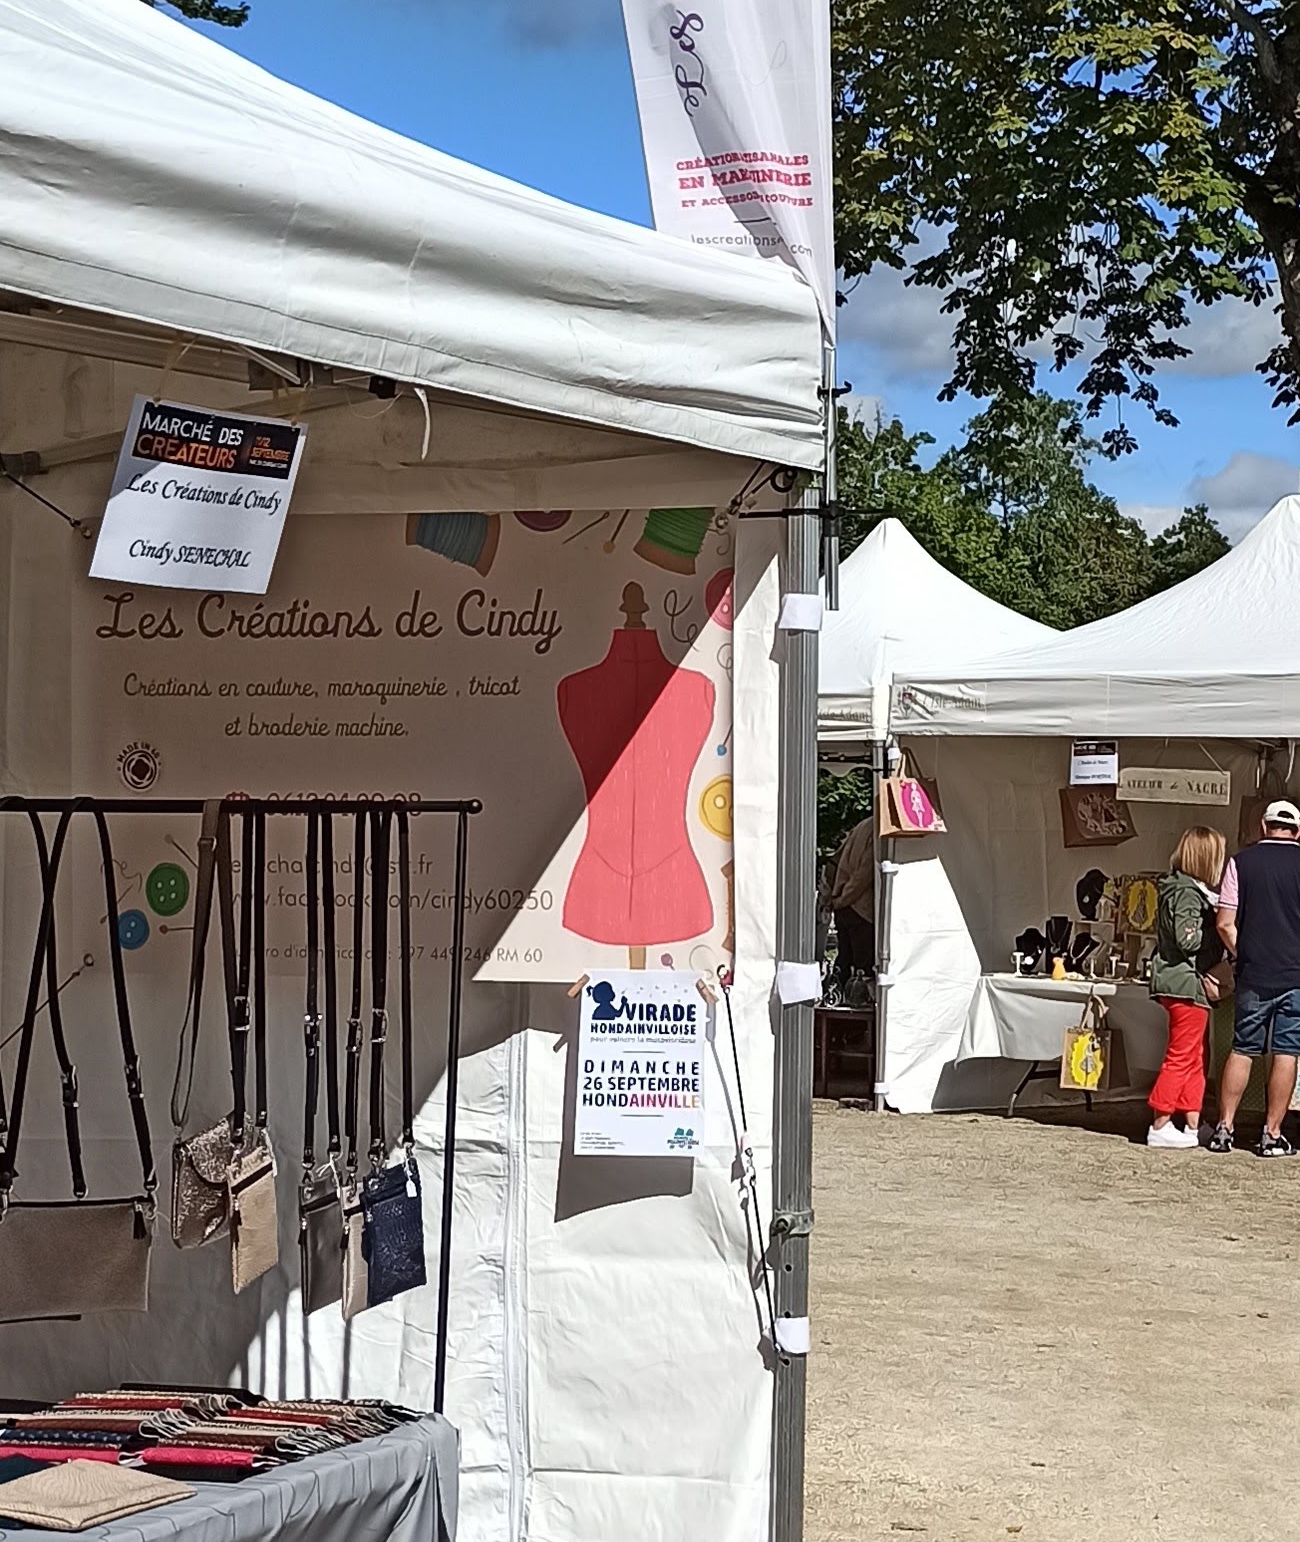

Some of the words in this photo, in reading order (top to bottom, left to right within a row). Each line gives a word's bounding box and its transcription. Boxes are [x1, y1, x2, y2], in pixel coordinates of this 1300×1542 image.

[670, 10, 707, 117] Les
[678, 176, 704, 189] EN
[681, 199, 697, 207] ET
[142, 411, 214, 442] MARCHÉ
[218, 427, 244, 446] DES
[125, 473, 159, 494] Les
[161, 479, 228, 506] Créations
[228, 486, 243, 506] de
[244, 490, 282, 516] Cindy
[129, 539, 174, 565] Cindy
[174, 545, 251, 568] SENECHAL
[96, 592, 183, 639] Les
[197, 593, 382, 639] Créations
[395, 590, 443, 638] de
[456, 588, 562, 654] Cindy
[123, 672, 212, 697] Créations
[218, 682, 241, 697] en
[245, 677, 319, 697] couture,
[327, 675, 448, 706] maroquinerie
[468, 675, 522, 697] tricot
[224, 716, 243, 737] et
[247, 712, 331, 737] broderie
[335, 712, 409, 737] machine.
[1186, 779, 1227, 796] NACRE
[464, 947, 491, 962] 246
[497, 948, 519, 962] RM
[524, 948, 543, 963] 60
[625, 1003, 697, 1022] VIRADE
[584, 1059, 700, 1076] DIMANCHE
[583, 1076, 603, 1091] 26
[607, 1077, 700, 1092] SEPTEMBRE
[582, 1093, 700, 1109] HONDAINVILLE
